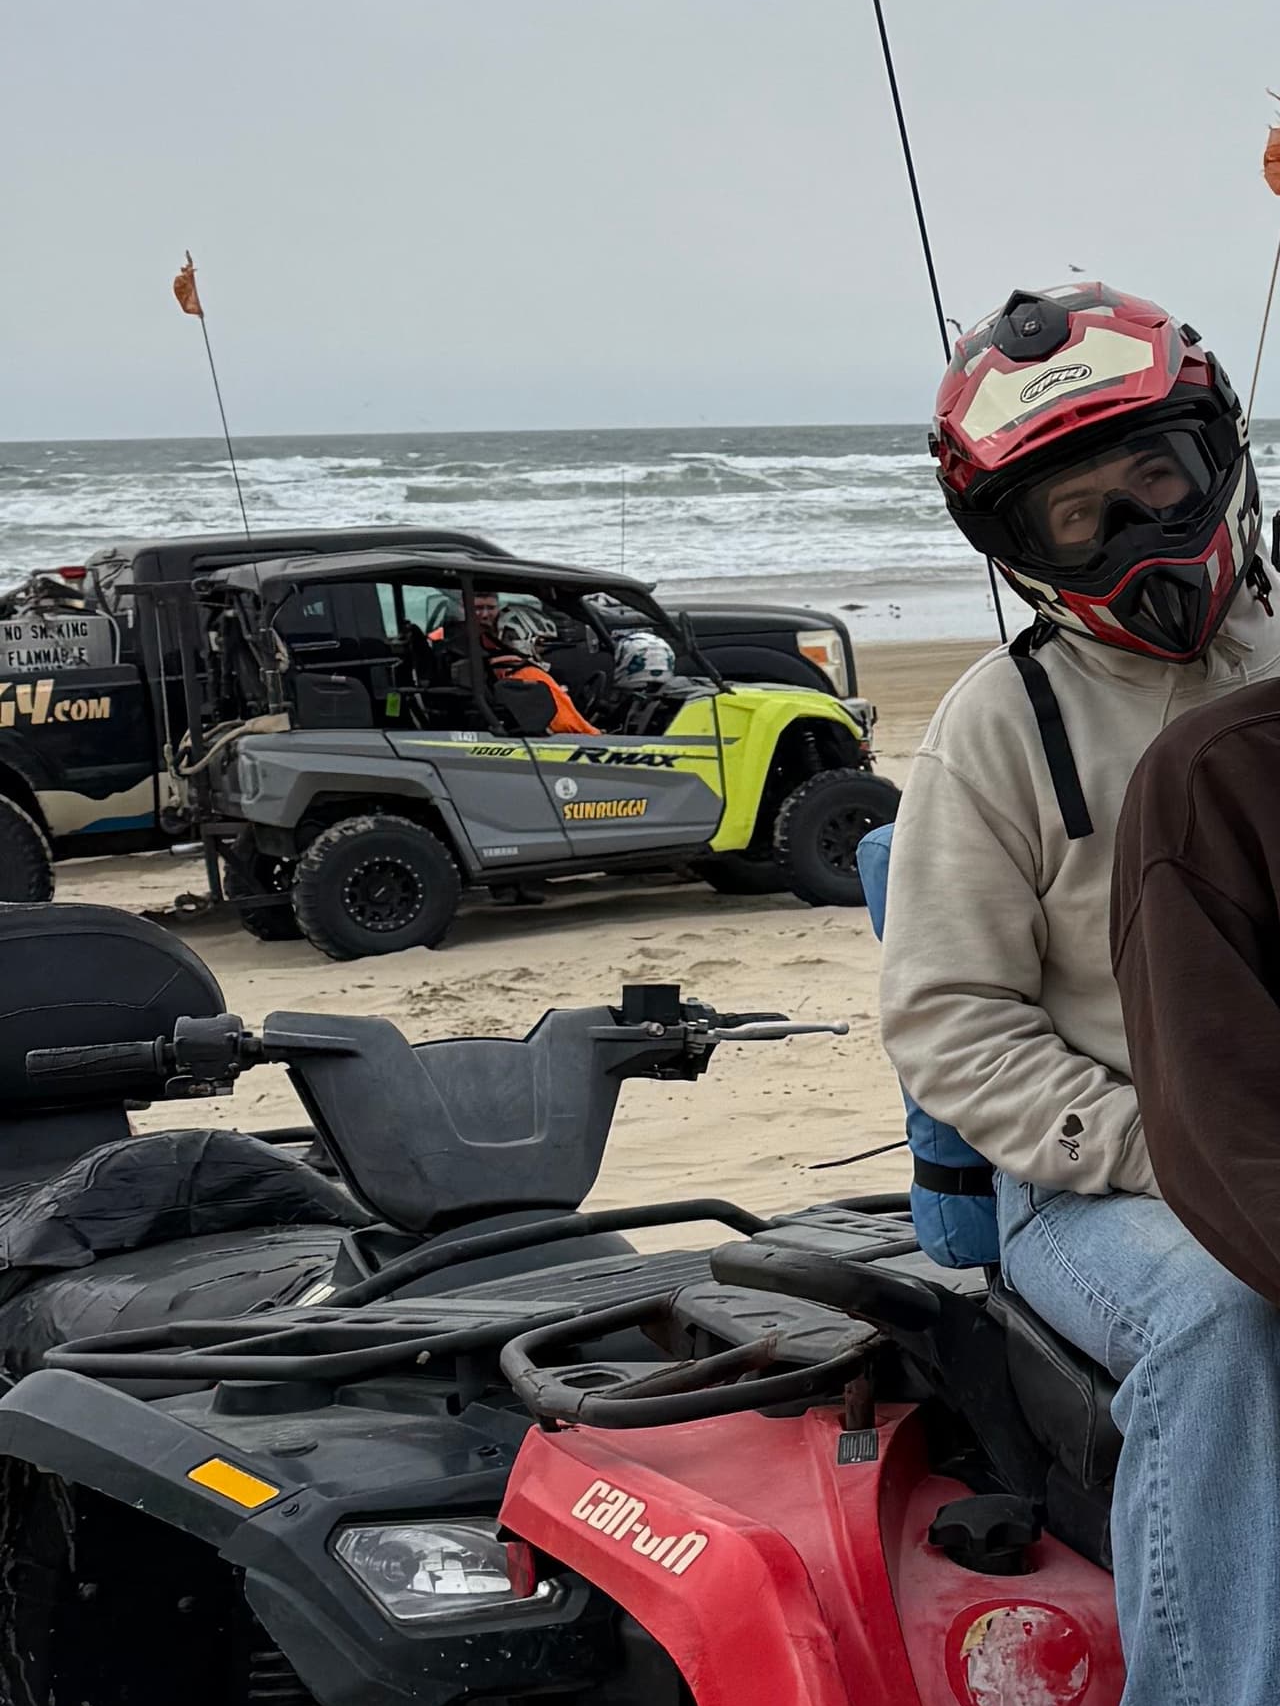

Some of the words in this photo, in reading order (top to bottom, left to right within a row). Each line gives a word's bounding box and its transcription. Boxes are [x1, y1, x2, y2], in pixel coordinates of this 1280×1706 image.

[4, 625, 22, 641] NO
[31, 621, 88, 640] SMKING
[8, 647, 86, 666] FLAMMABE
[469, 746, 516, 757] 1000
[566, 746, 681, 768] RMAX
